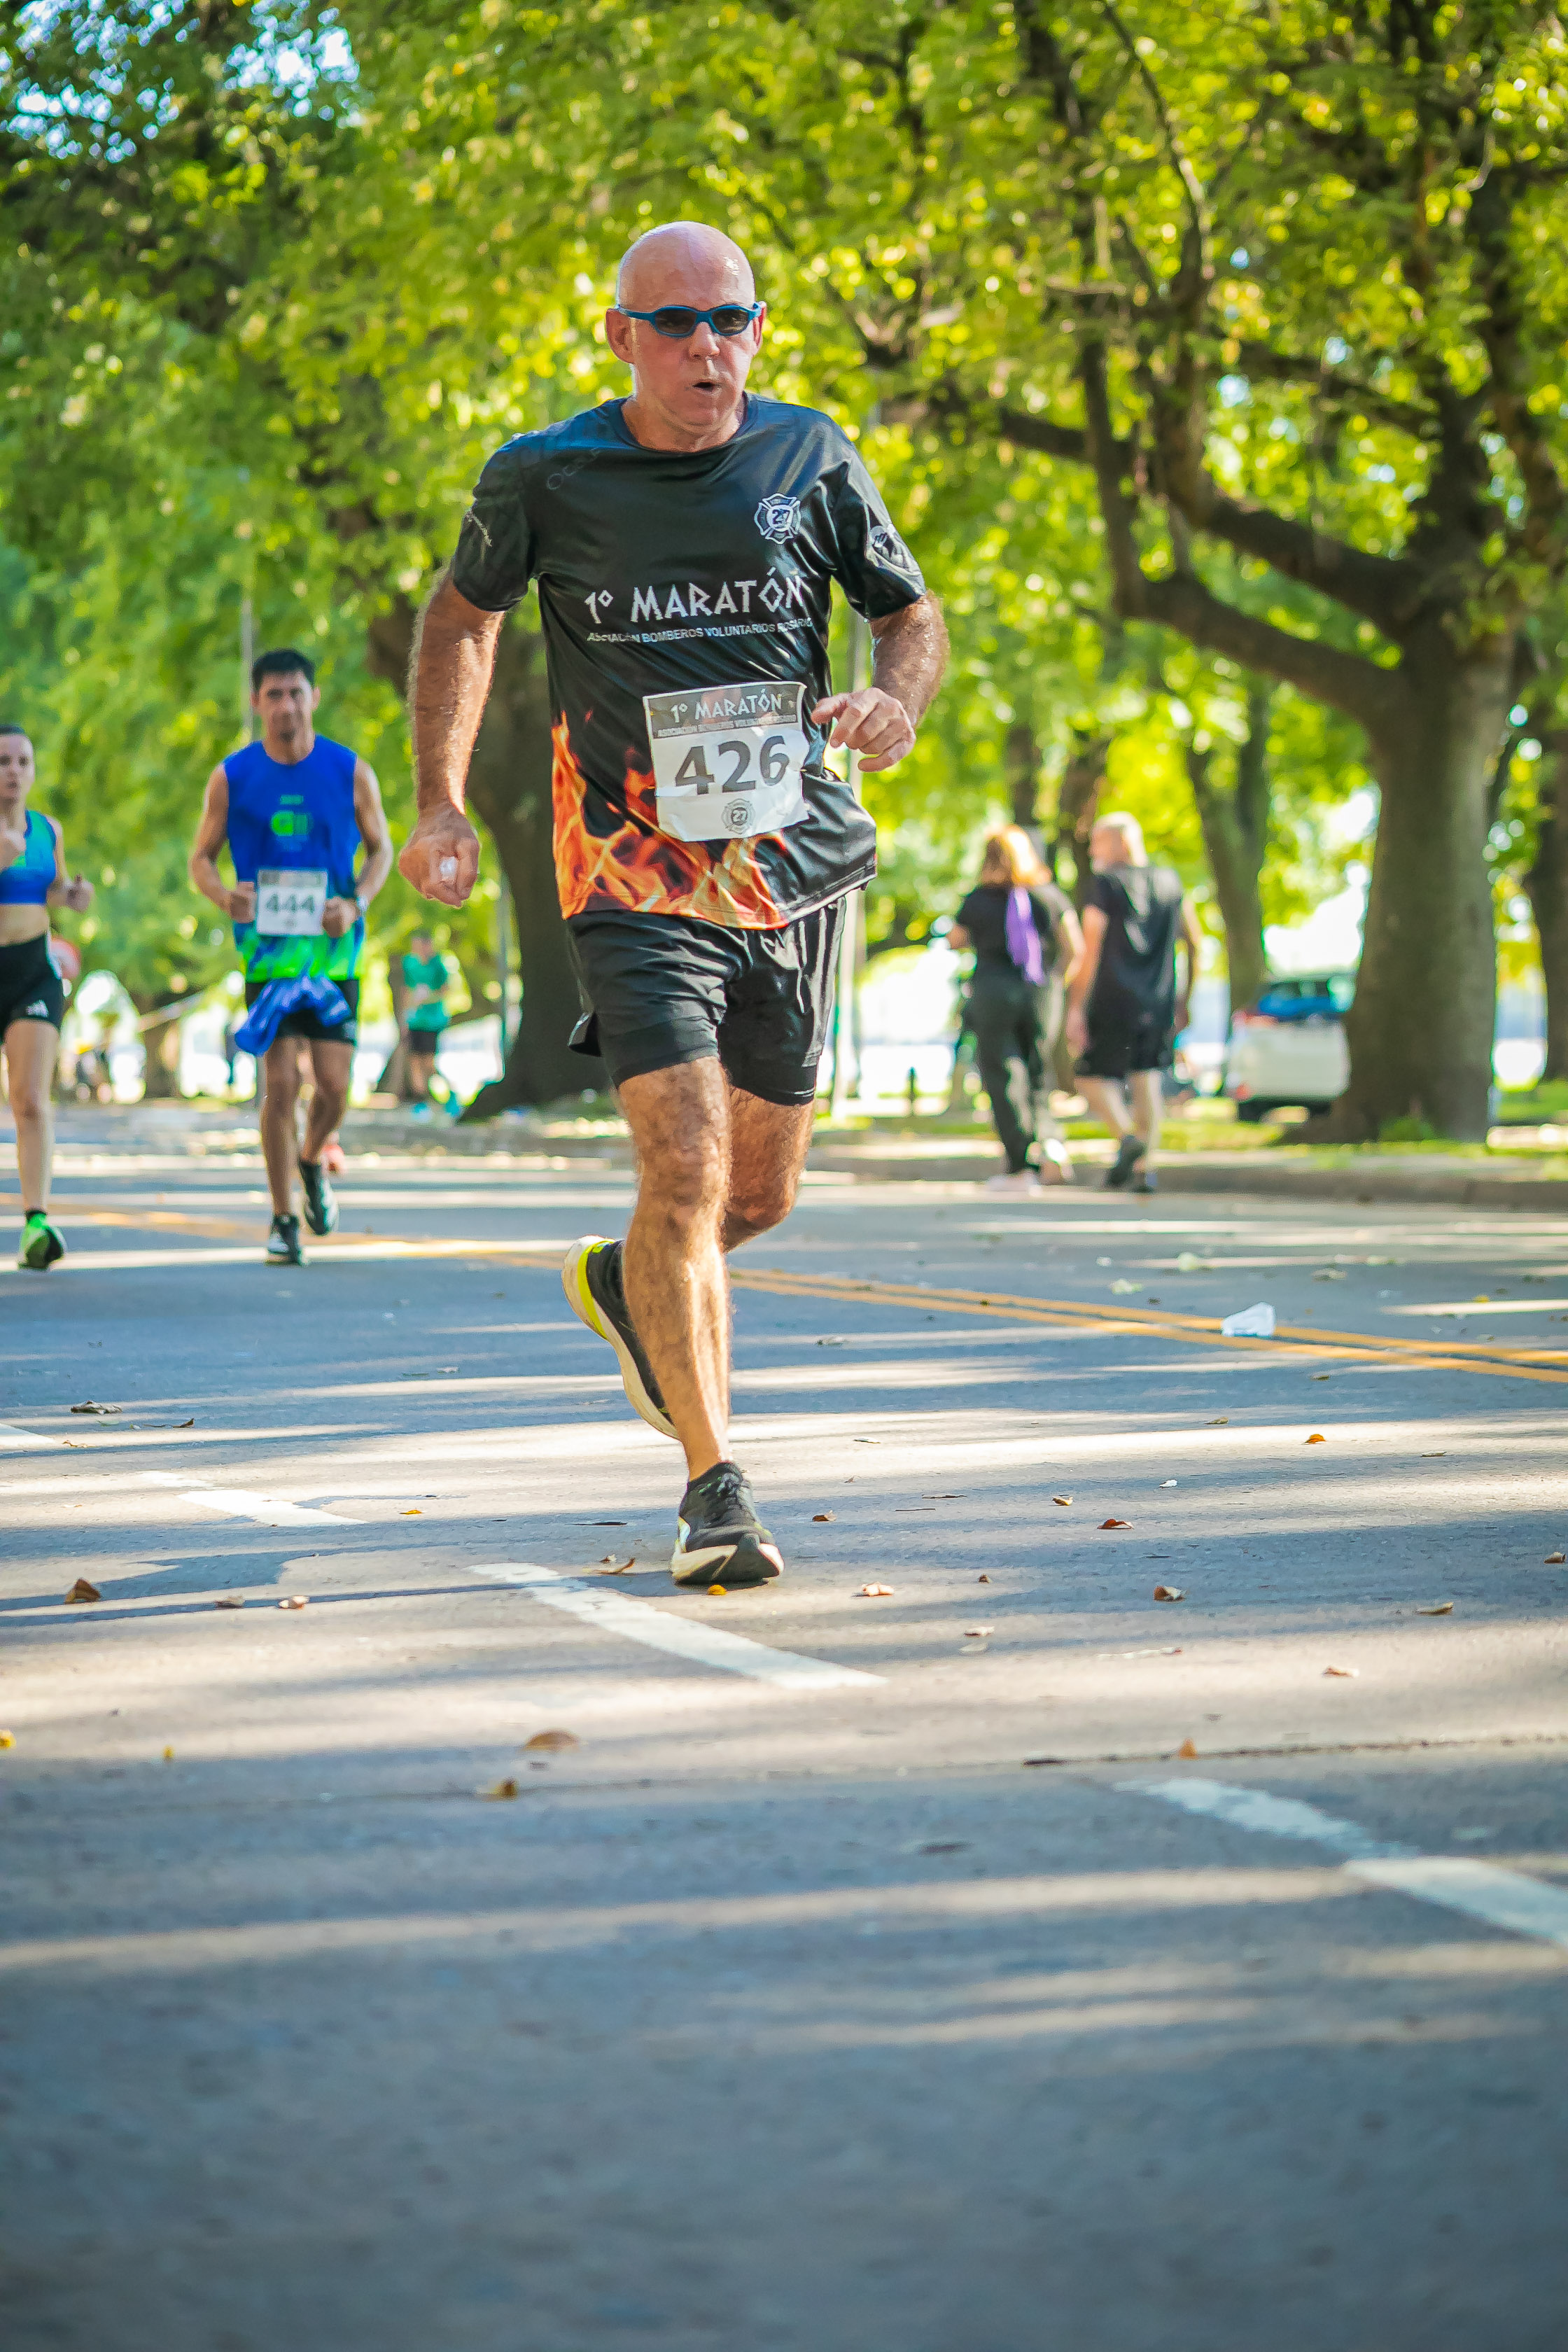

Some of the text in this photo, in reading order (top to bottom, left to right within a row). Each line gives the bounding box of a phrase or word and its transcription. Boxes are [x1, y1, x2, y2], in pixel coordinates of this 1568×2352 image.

[630, 567, 807, 623] MARATÓN
[642, 627, 704, 643] BOMBEROS
[704, 624, 776, 636] VOLUNTARIOS
[694, 688, 783, 720] MARATÓN
[675, 736, 790, 795] 426
[265, 893, 315, 916] 444
